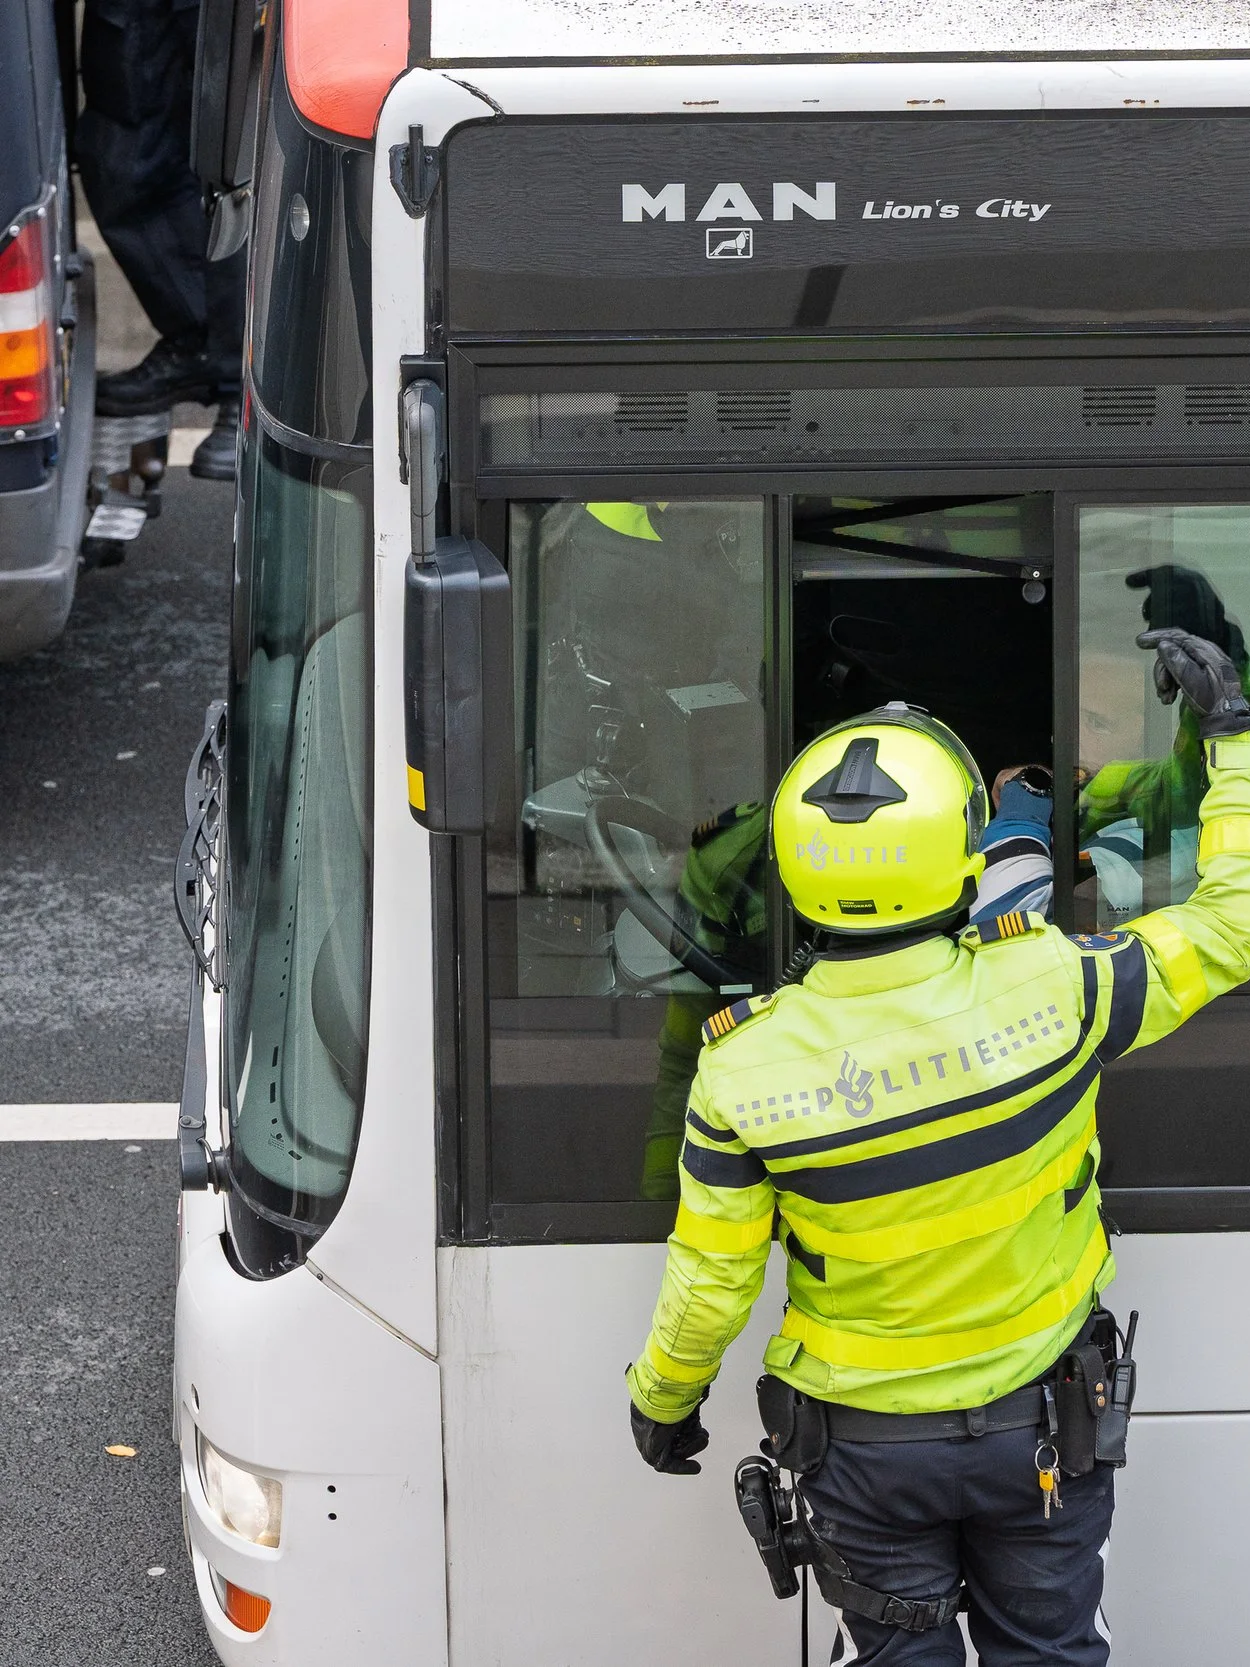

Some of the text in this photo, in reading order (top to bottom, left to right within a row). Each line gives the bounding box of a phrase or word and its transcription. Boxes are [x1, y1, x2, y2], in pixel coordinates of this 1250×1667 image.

[621, 182, 837, 223] MAN
[862, 198, 1052, 222] Lion's City
[796, 831, 908, 871] POLITIE
[816, 1039, 996, 1119] POLITIE
